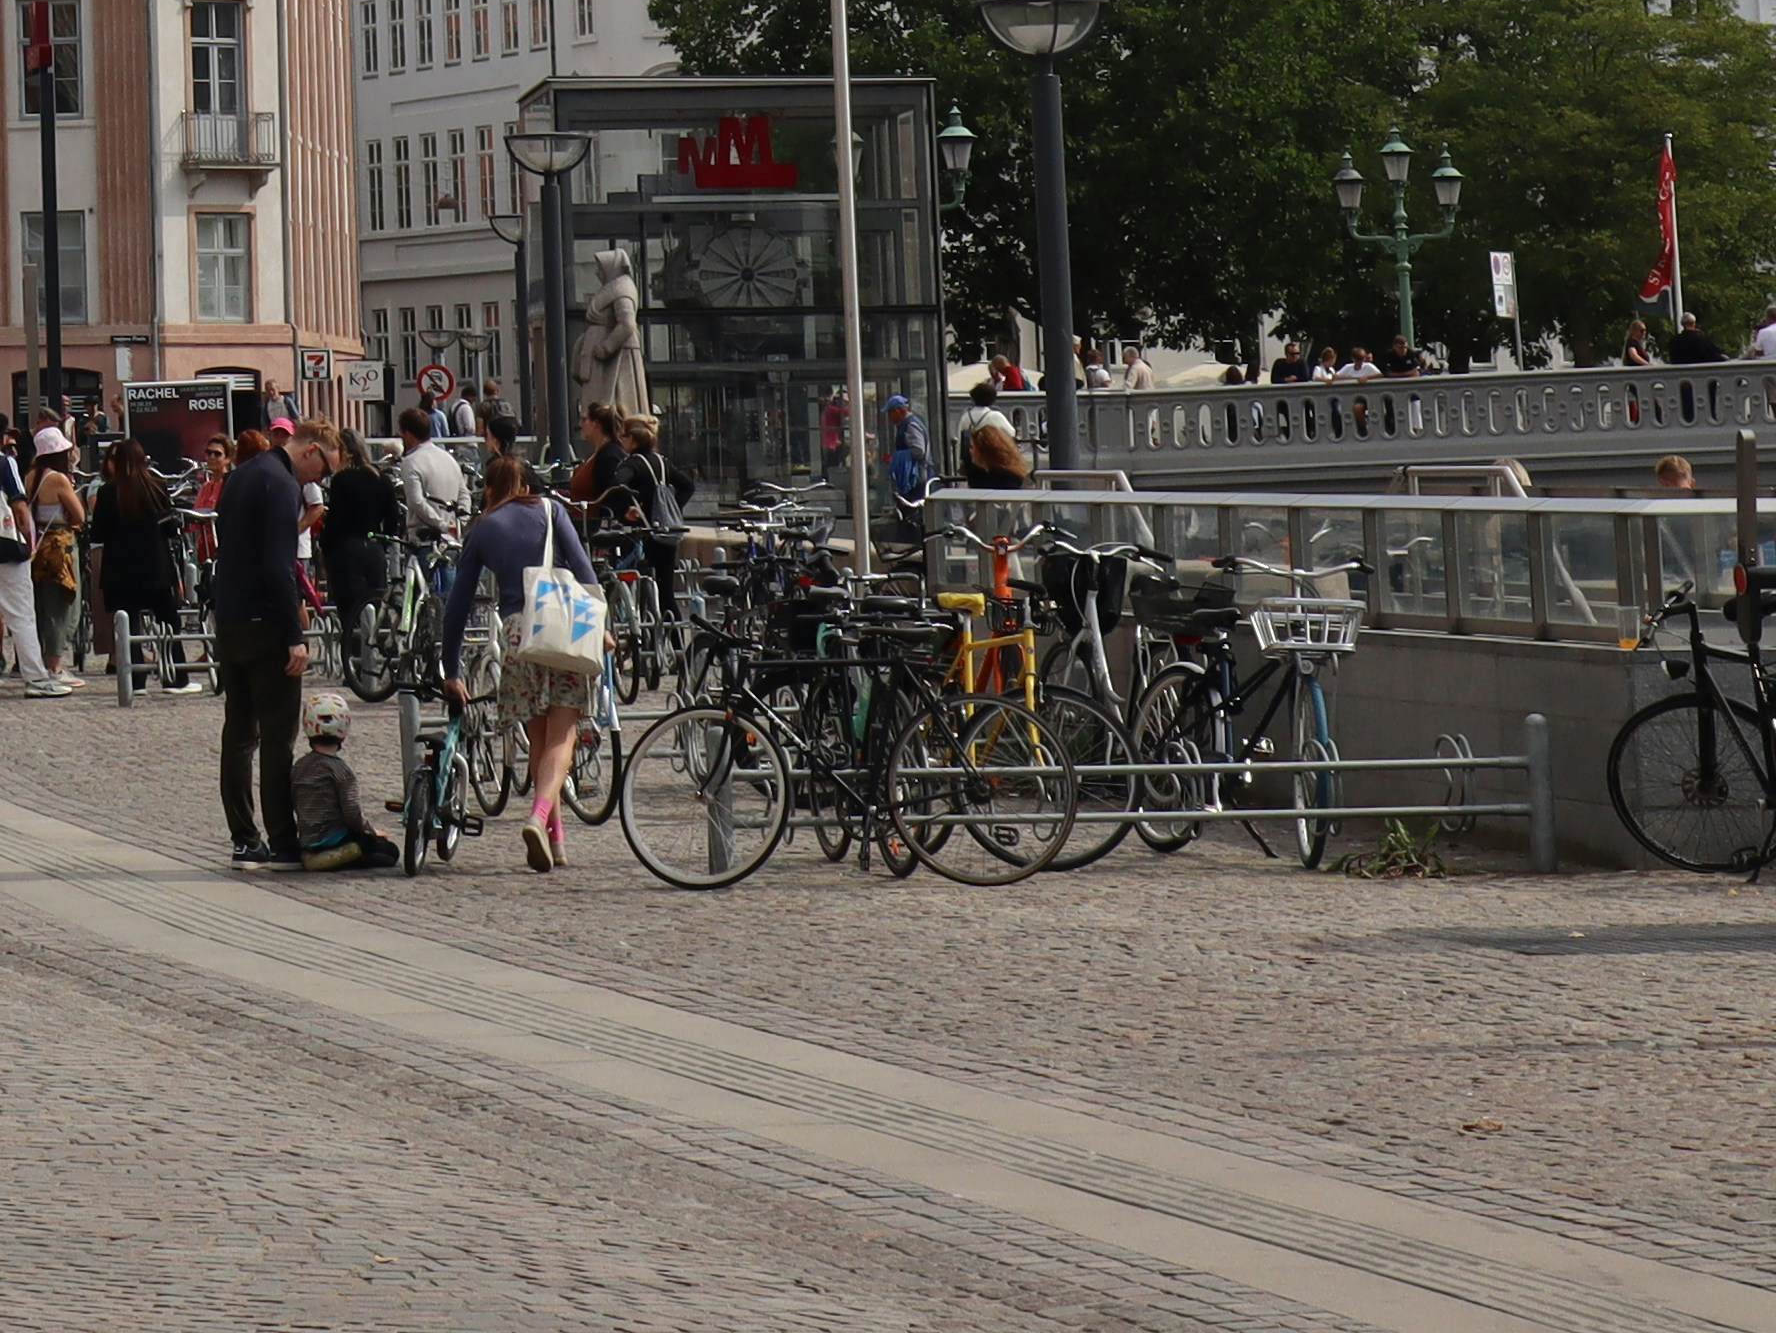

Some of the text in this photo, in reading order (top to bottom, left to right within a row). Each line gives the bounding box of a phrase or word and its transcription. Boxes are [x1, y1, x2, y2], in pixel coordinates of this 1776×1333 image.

[306, 354, 325, 379] 7
[128, 387, 180, 401] RACHEL
[188, 398, 225, 411] ROSE
